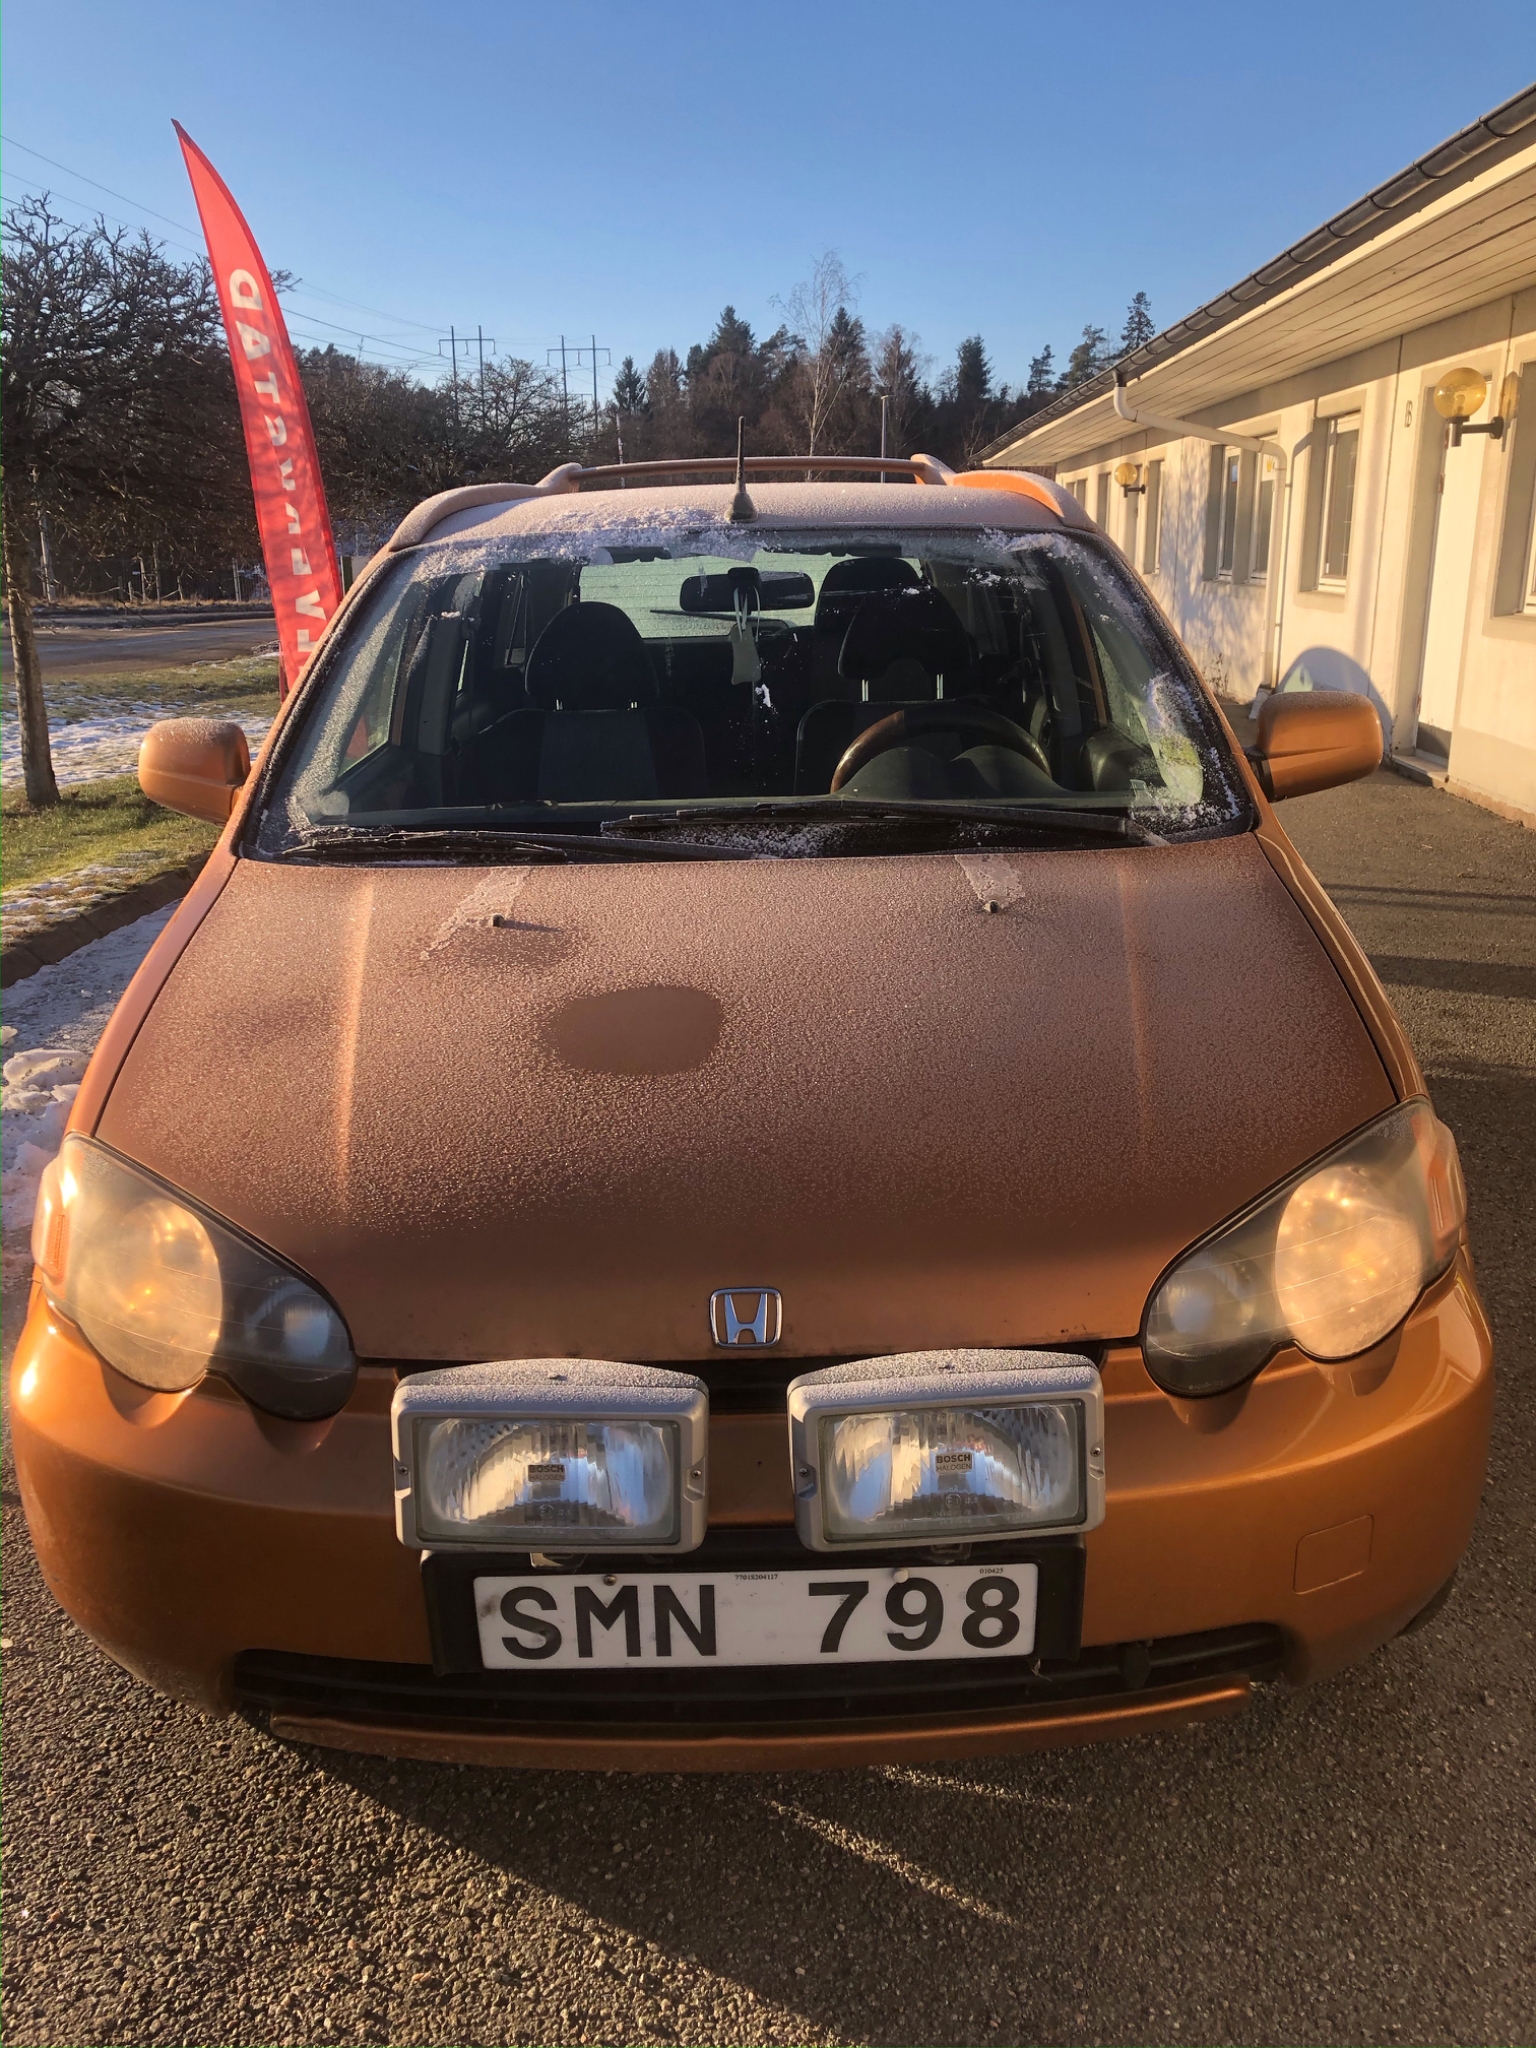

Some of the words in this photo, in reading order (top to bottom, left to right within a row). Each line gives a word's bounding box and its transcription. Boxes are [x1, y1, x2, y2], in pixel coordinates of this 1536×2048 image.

[936, 1453, 971, 1463] BOSCH
[529, 1464, 565, 1473] BOSCH
[936, 1463, 971, 1471] HALOGEN
[500, 1586, 717, 1660] SMN
[808, 1577, 1021, 1654] 798
